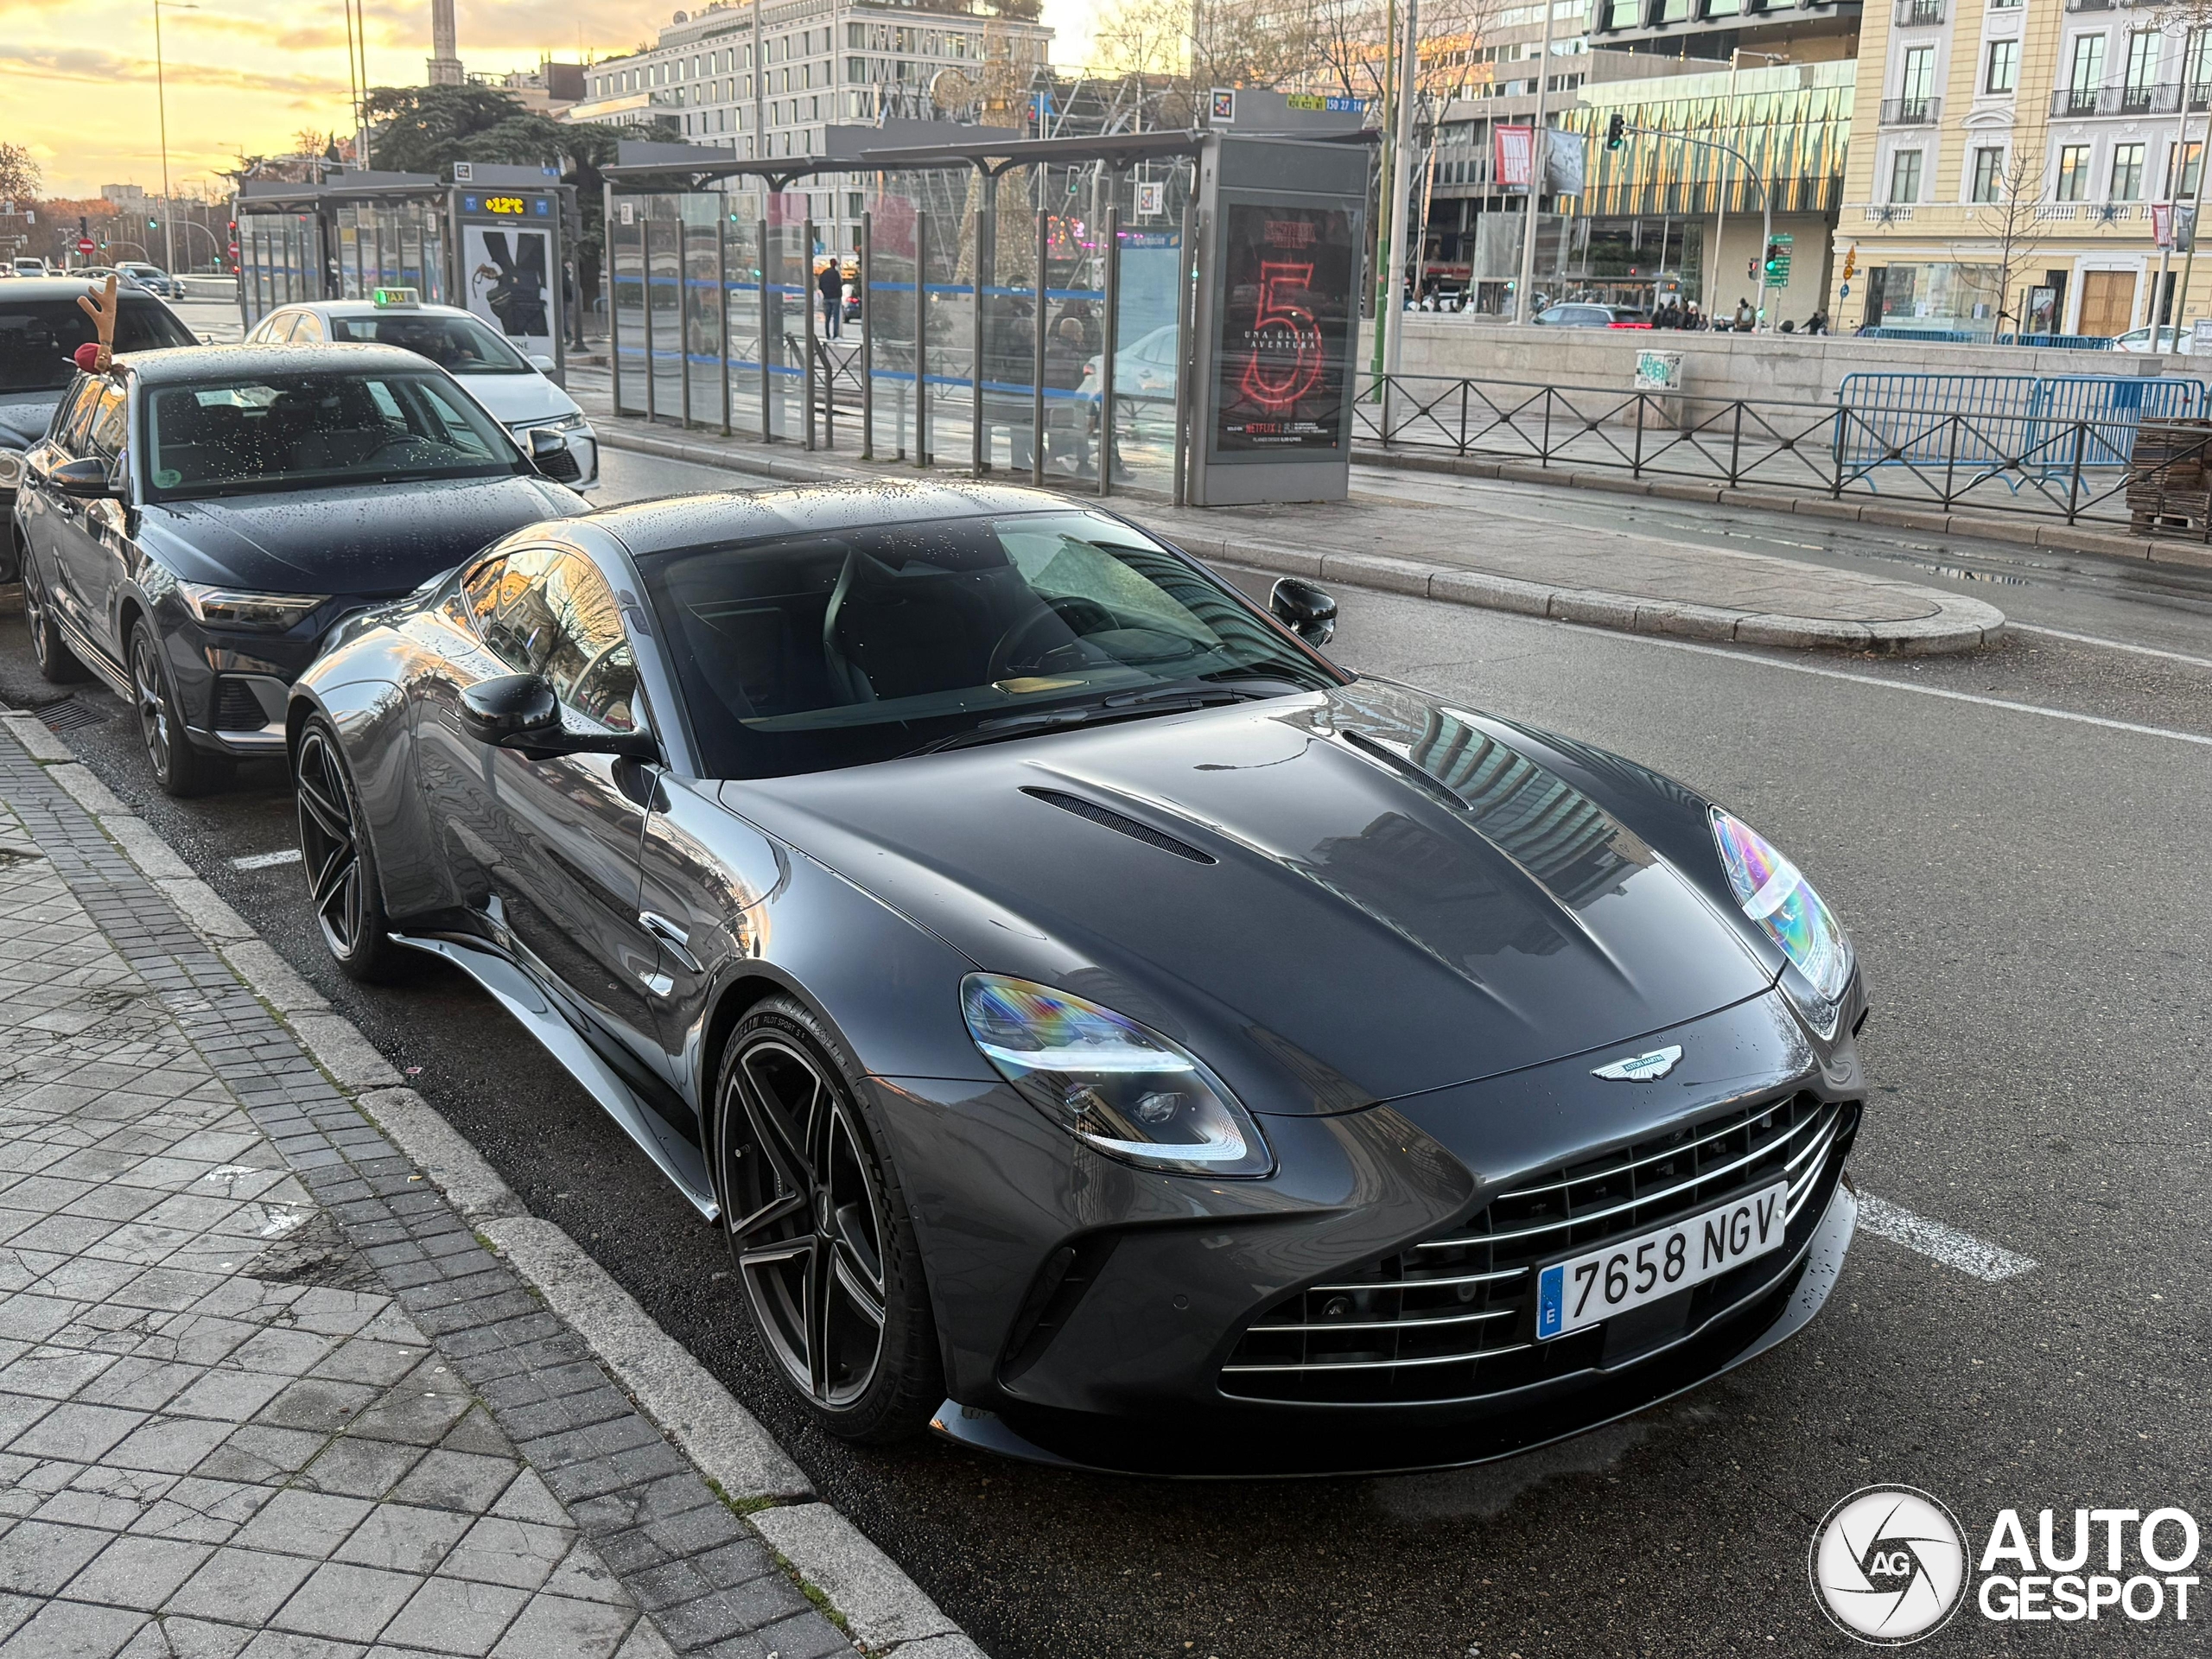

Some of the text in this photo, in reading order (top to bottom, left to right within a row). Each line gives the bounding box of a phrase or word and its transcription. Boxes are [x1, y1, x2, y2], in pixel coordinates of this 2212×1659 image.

[1326, 99, 1338, 111] 150
[1340, 100, 1350, 111] 27
[1353, 101, 1362, 112] 14
[1278, 329, 1322, 340] ÚLTIMA
[1250, 340, 1315, 349] AVENTURA
[1246, 423, 1275, 434] NETFLIX
[763, 1015, 778, 1025] PILOT
[778, 1016, 796, 1033] SPORT
[1625, 1055, 1663, 1071] ASTON MARTIN
[1573, 1192, 1777, 1318] 7658 NGV
[1547, 1308, 1555, 1324] E
